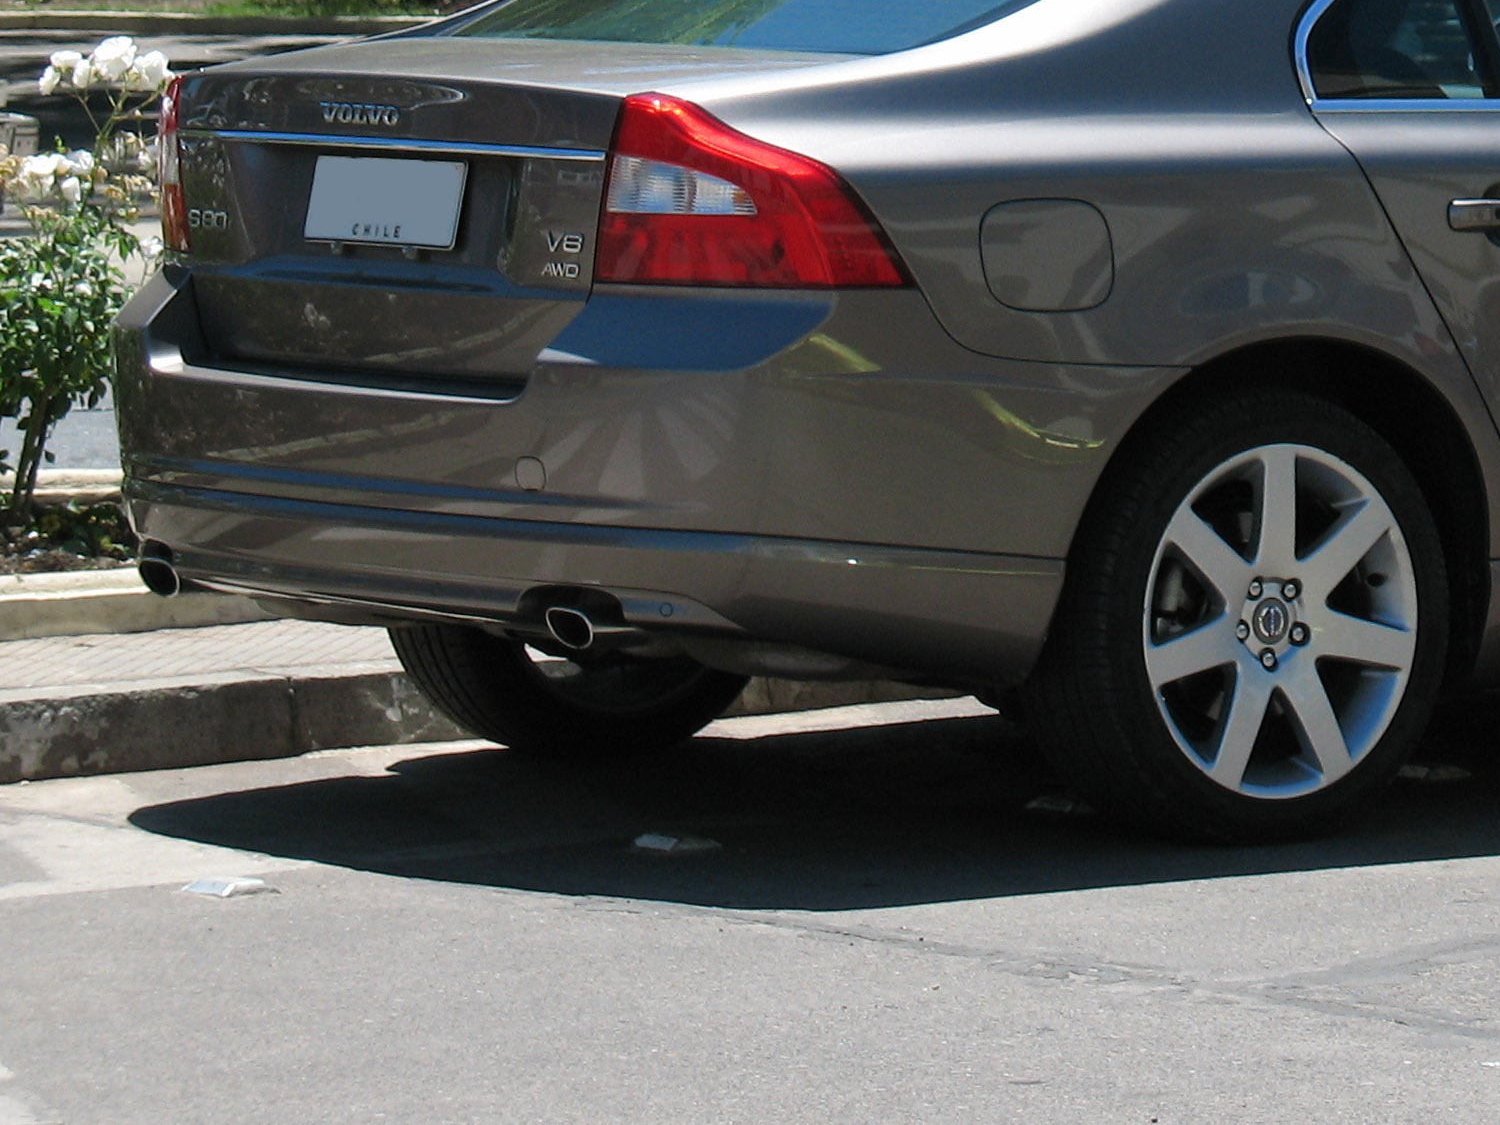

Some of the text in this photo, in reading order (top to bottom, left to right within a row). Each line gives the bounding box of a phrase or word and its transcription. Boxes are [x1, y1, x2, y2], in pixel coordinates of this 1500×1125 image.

[320, 101, 399, 127] VOLVO
[188, 208, 228, 230] S80
[352, 222, 402, 239] CHILE
[546, 229, 584, 254] V8
[540, 262, 580, 280] AWD
